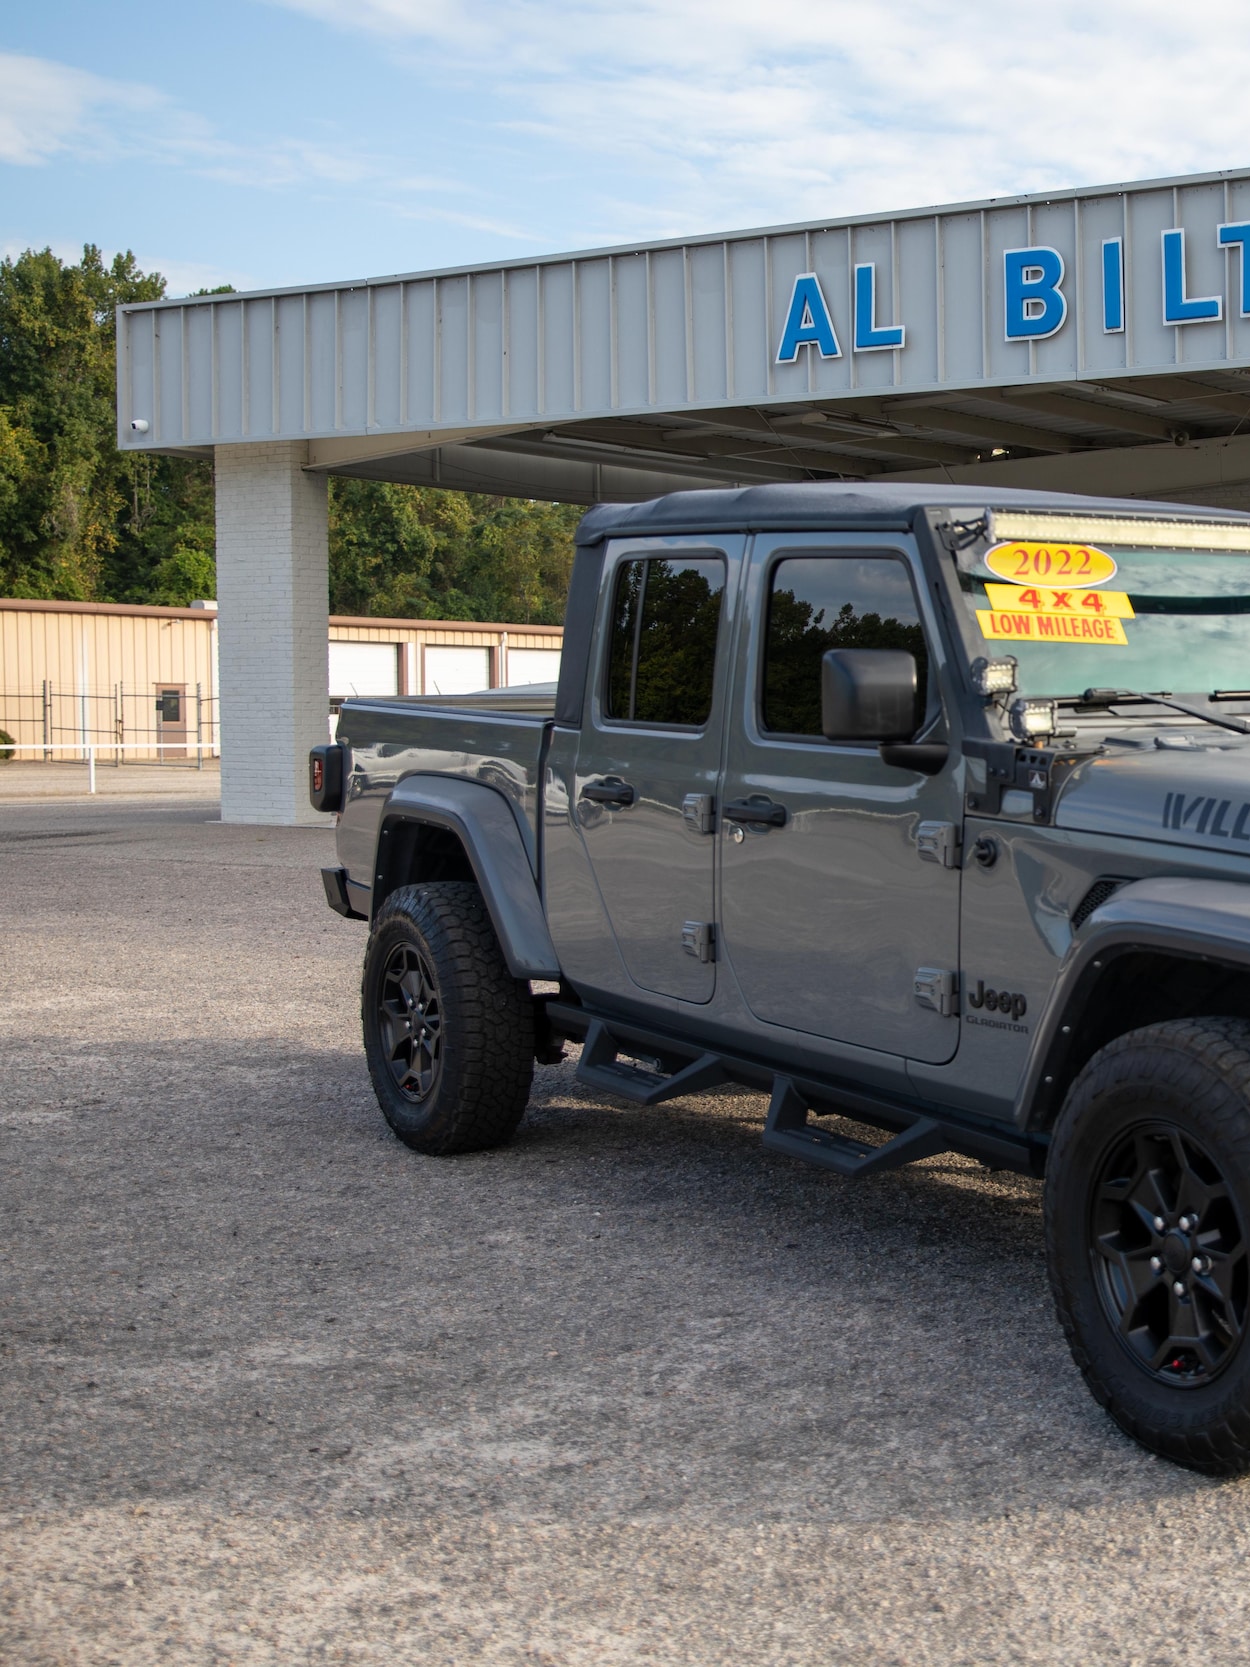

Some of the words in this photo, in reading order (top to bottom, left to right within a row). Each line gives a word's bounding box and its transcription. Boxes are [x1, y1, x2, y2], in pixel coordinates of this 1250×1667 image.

[776, 261, 905, 364] AL
[1013, 549, 1093, 575] 2022
[990, 613, 1031, 635] LOW
[1037, 616, 1116, 639] MILEAGE
[968, 980, 1028, 1021] Jeep
[965, 1015, 1030, 1035] GLADIATOR
